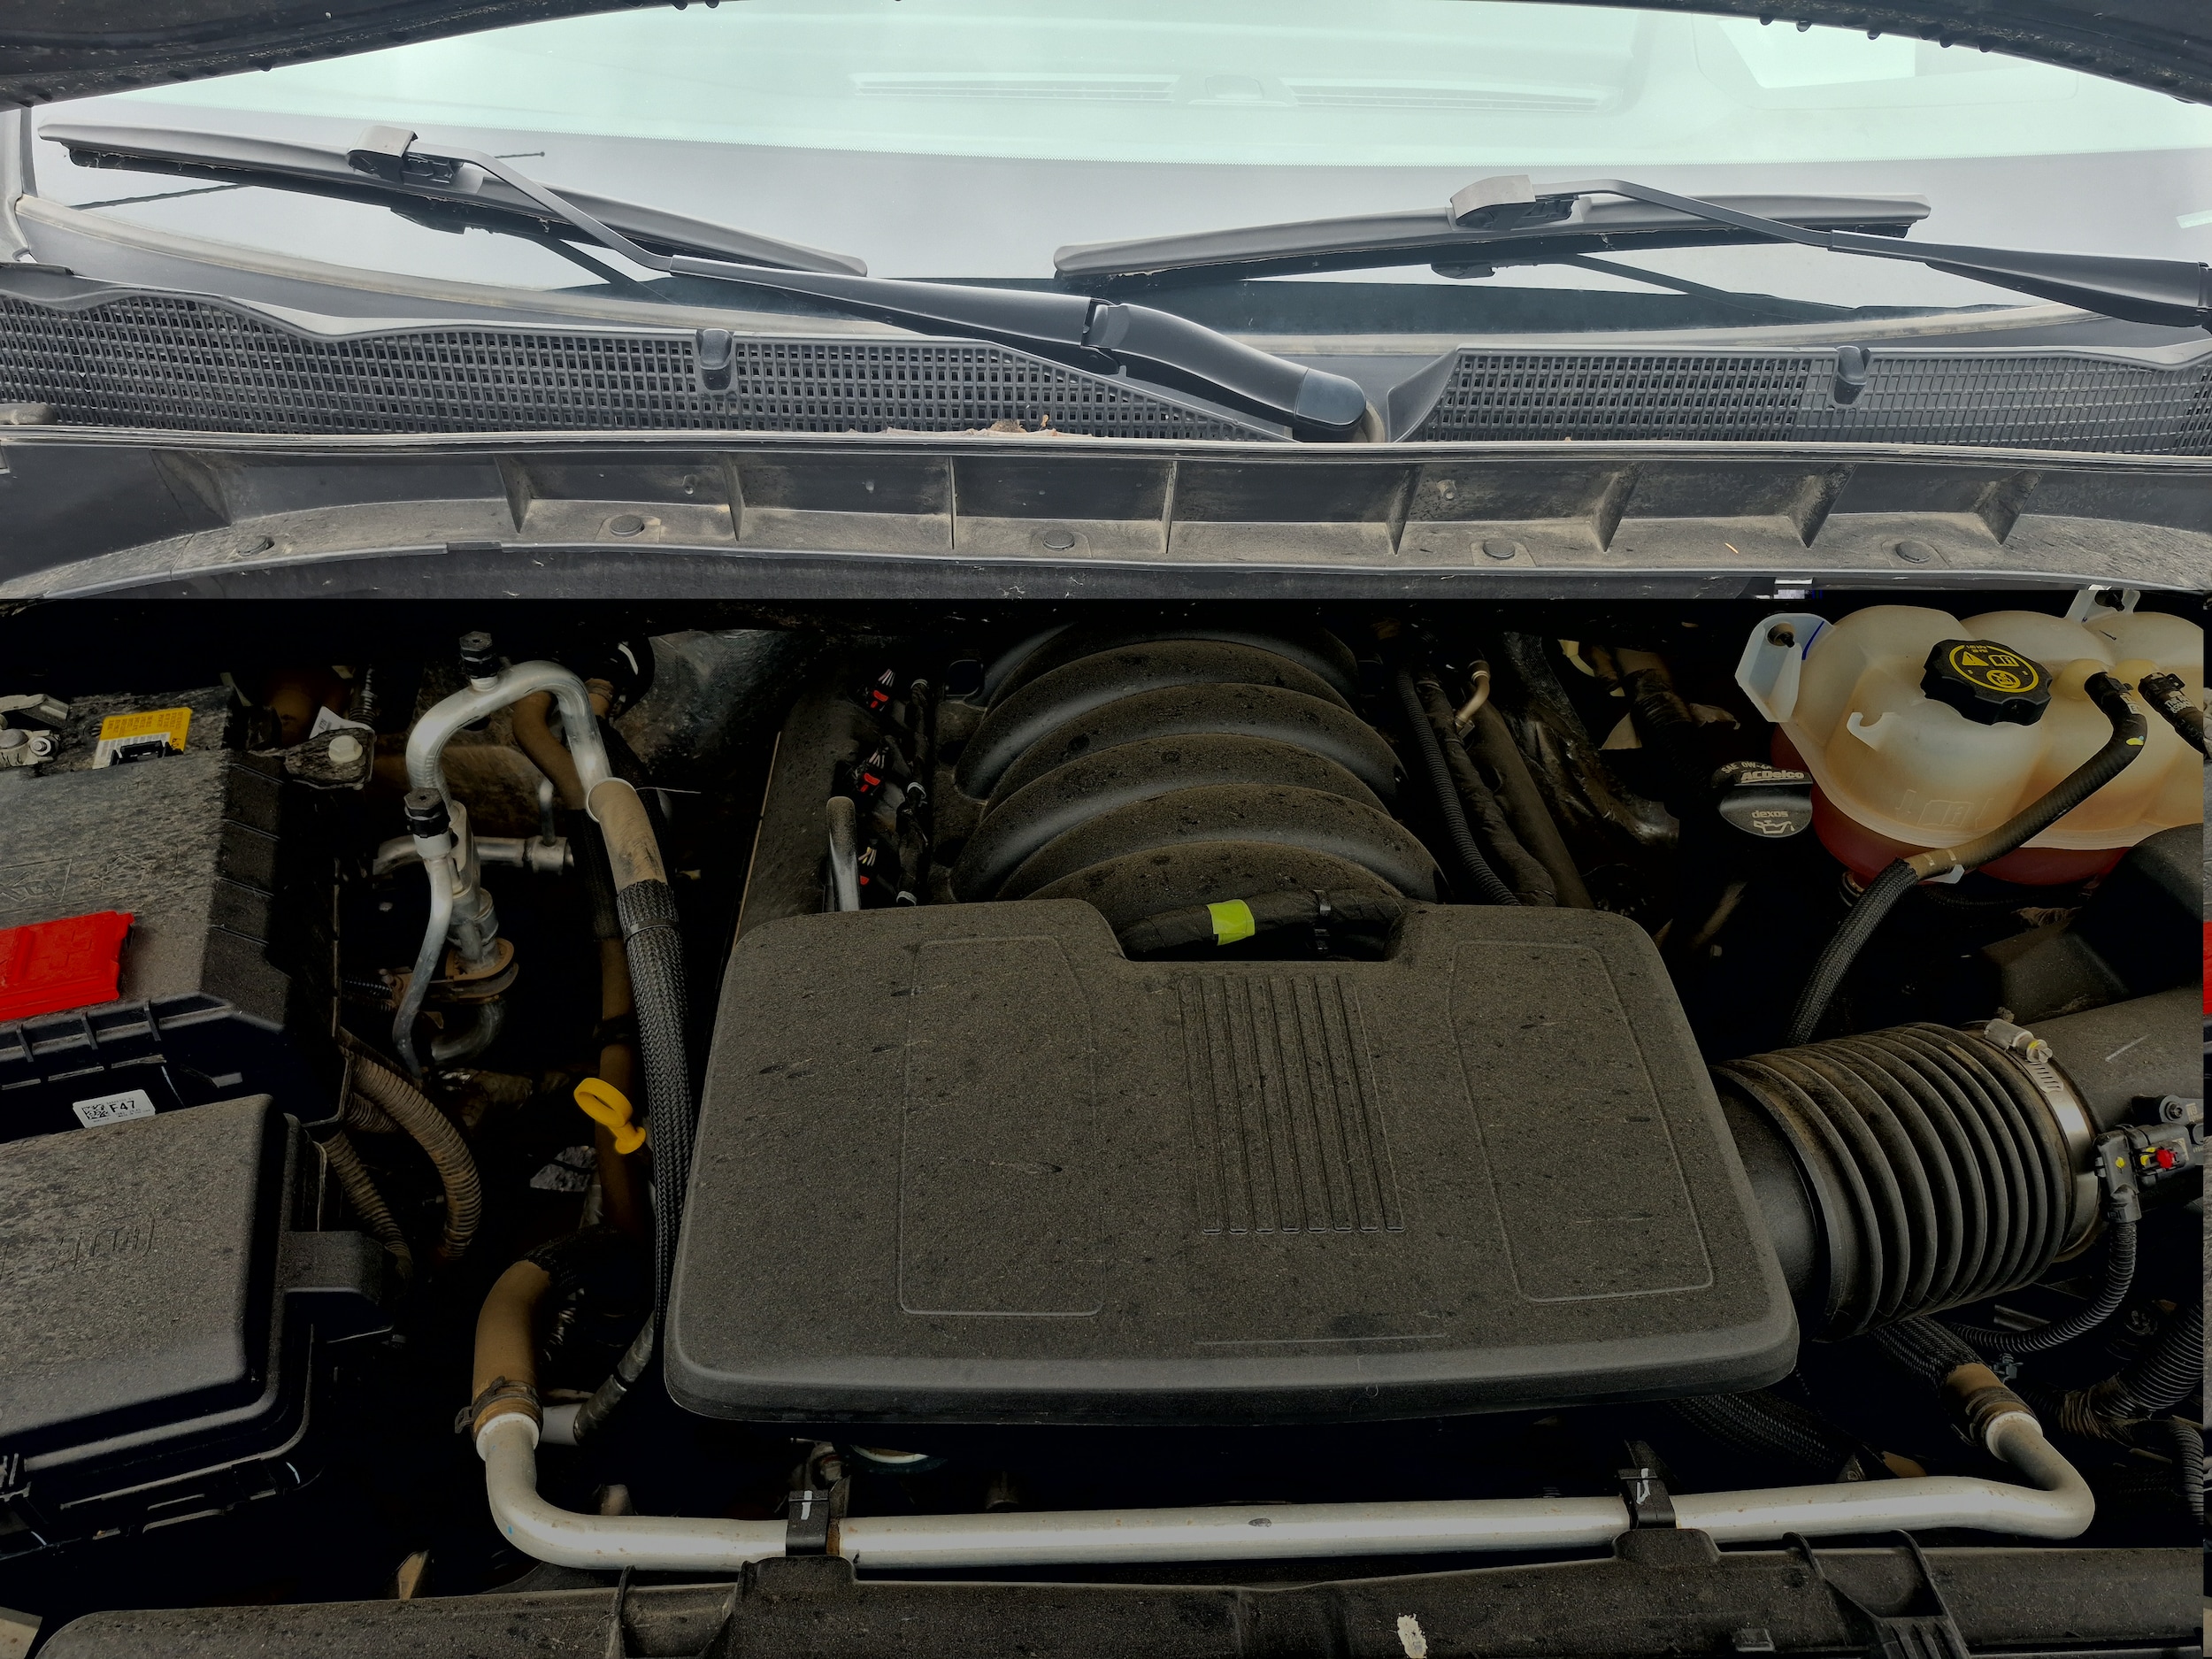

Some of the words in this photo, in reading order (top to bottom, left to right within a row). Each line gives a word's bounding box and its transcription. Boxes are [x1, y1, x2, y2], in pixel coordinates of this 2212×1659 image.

[1721, 763, 1740, 774] SAE
[1740, 770, 1805, 780] ACDelco
[1751, 810, 1789, 818] dexos
[109, 1100, 135, 1113] F47
